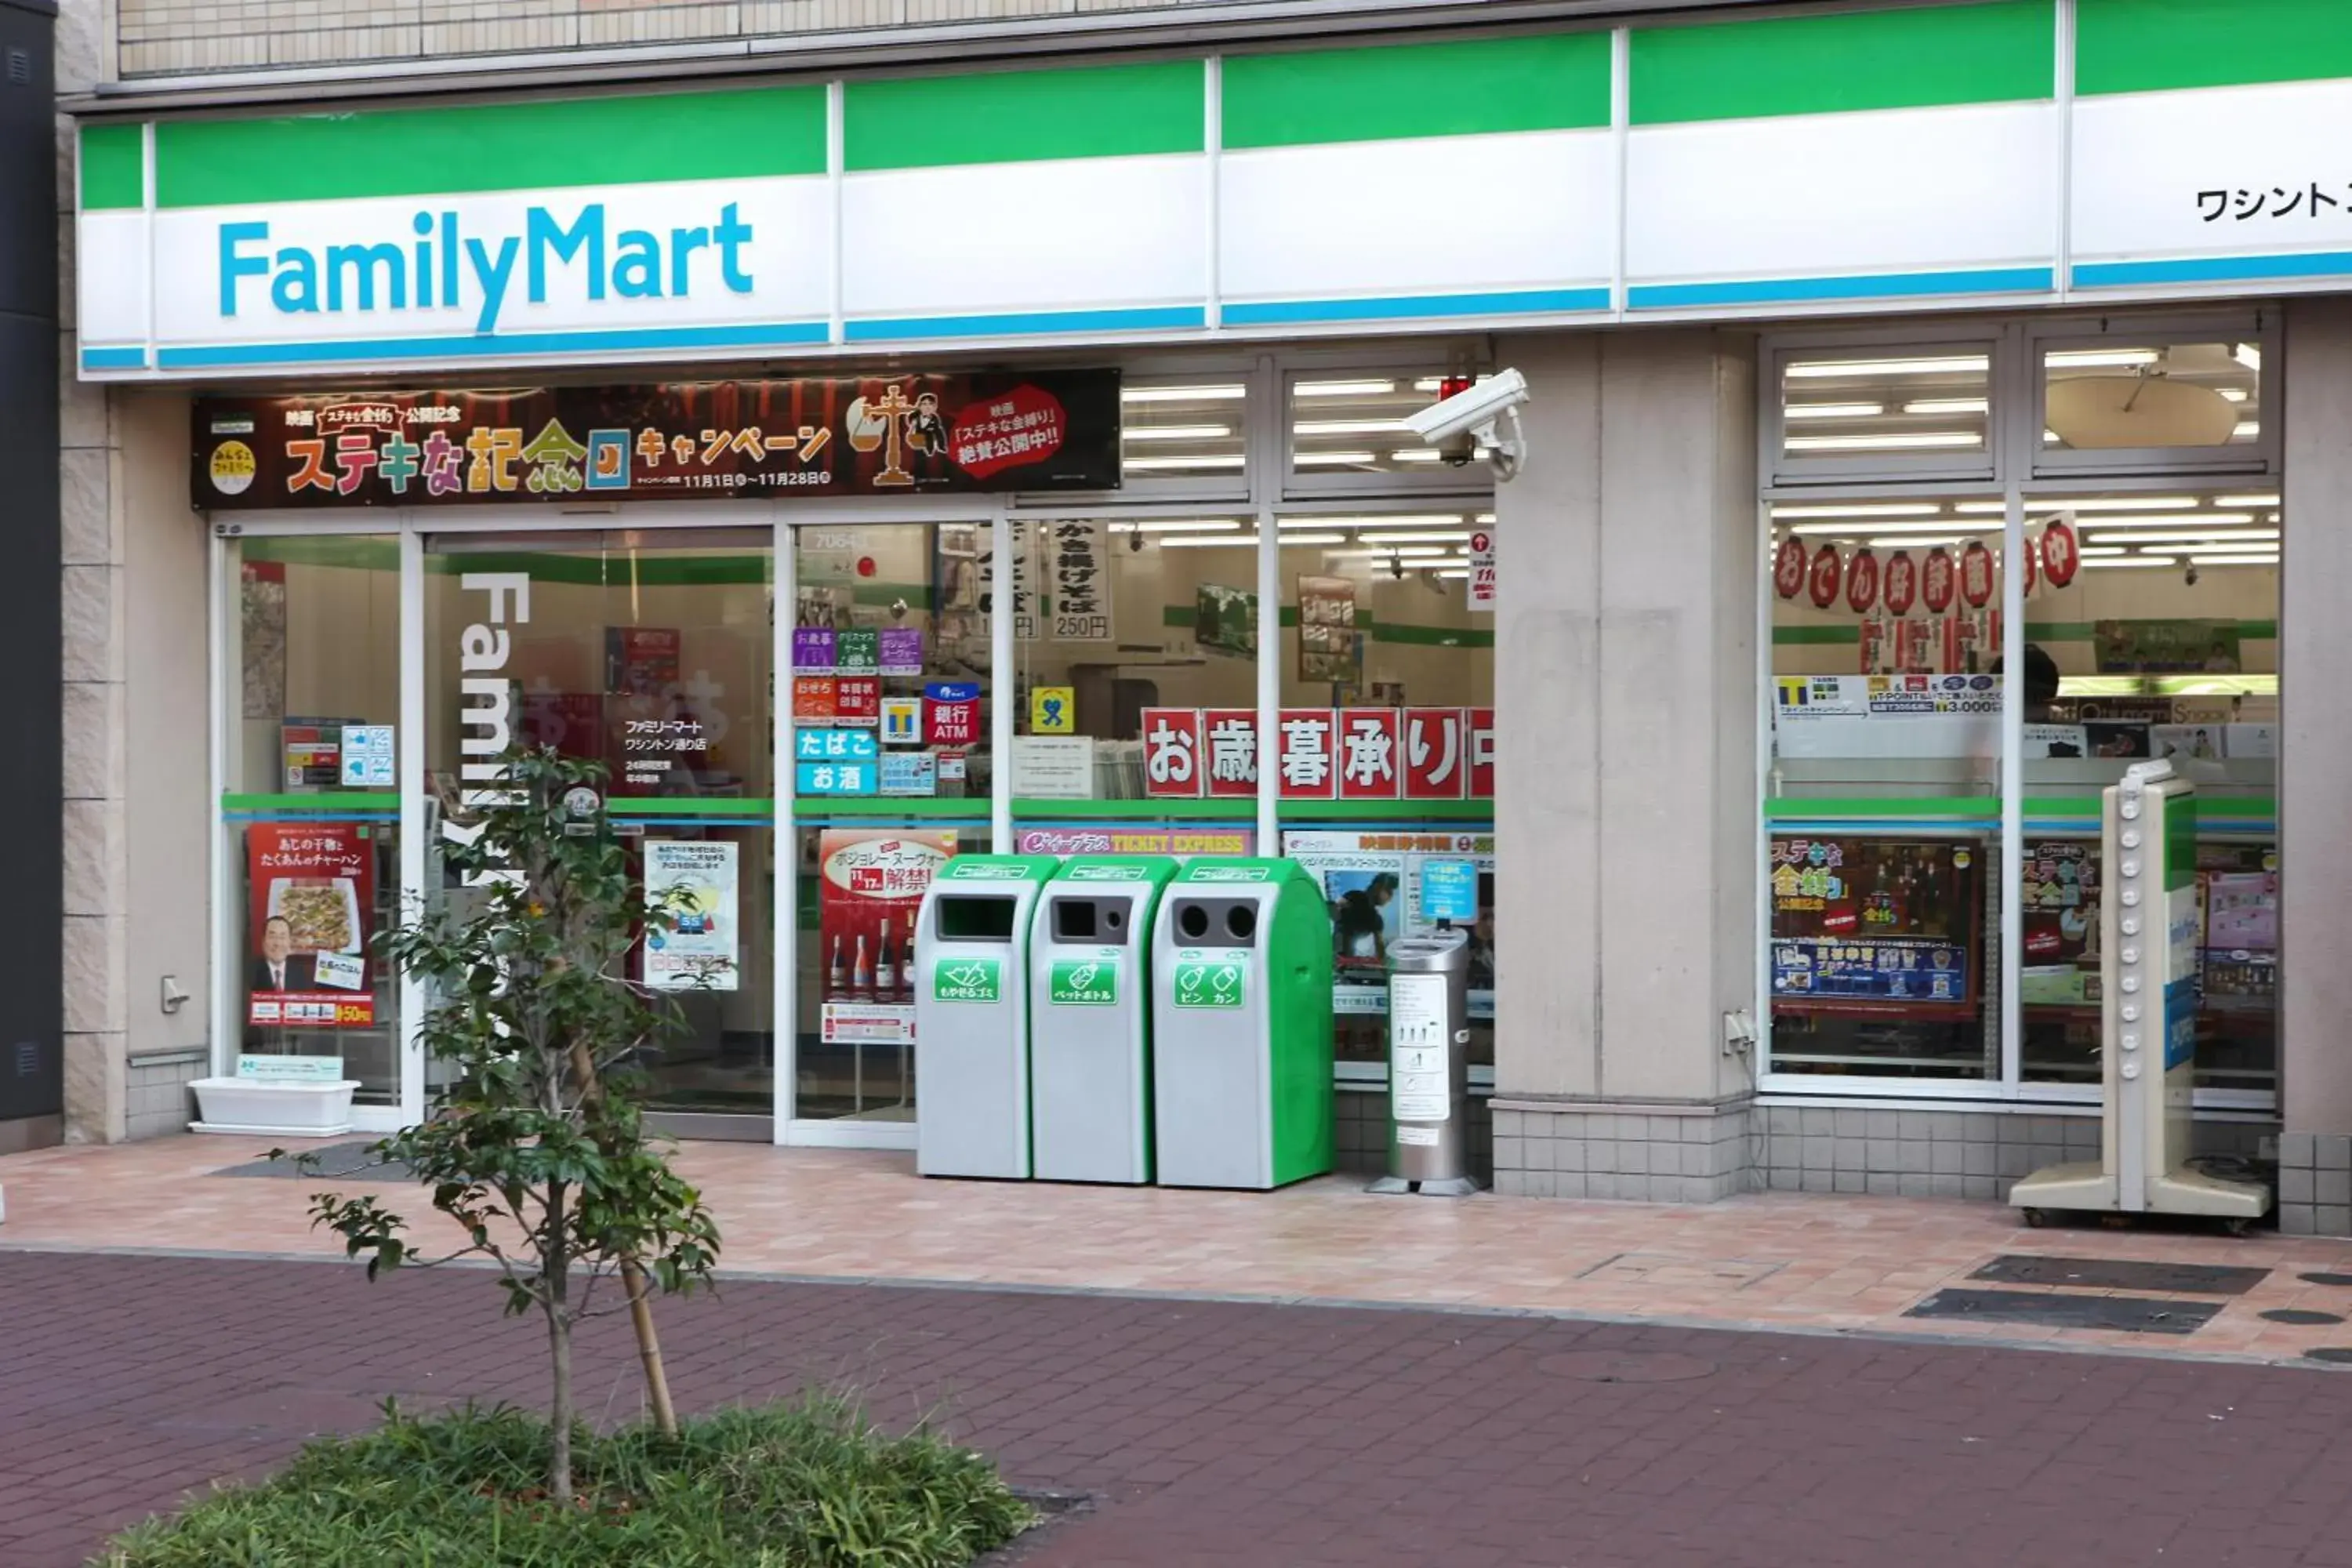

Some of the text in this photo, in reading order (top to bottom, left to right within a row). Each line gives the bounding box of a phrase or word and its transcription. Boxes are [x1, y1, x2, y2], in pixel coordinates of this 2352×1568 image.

[219, 201, 753, 336] FamilyMart
[636, 427, 831, 466] キャンペーン
[1057, 616, 1107, 638] 250円
[935, 705, 969, 724] 銀行
[625, 720, 703, 735] ファミリーマート
[934, 725, 969, 739] ATM
[802, 732, 871, 755] たばこ
[813, 766, 861, 790] お酒
[1112, 834, 1168, 852] TICKET
[1173, 834, 1243, 852] EXPRESS
[1054, 990, 1111, 1001] ペットボトル
